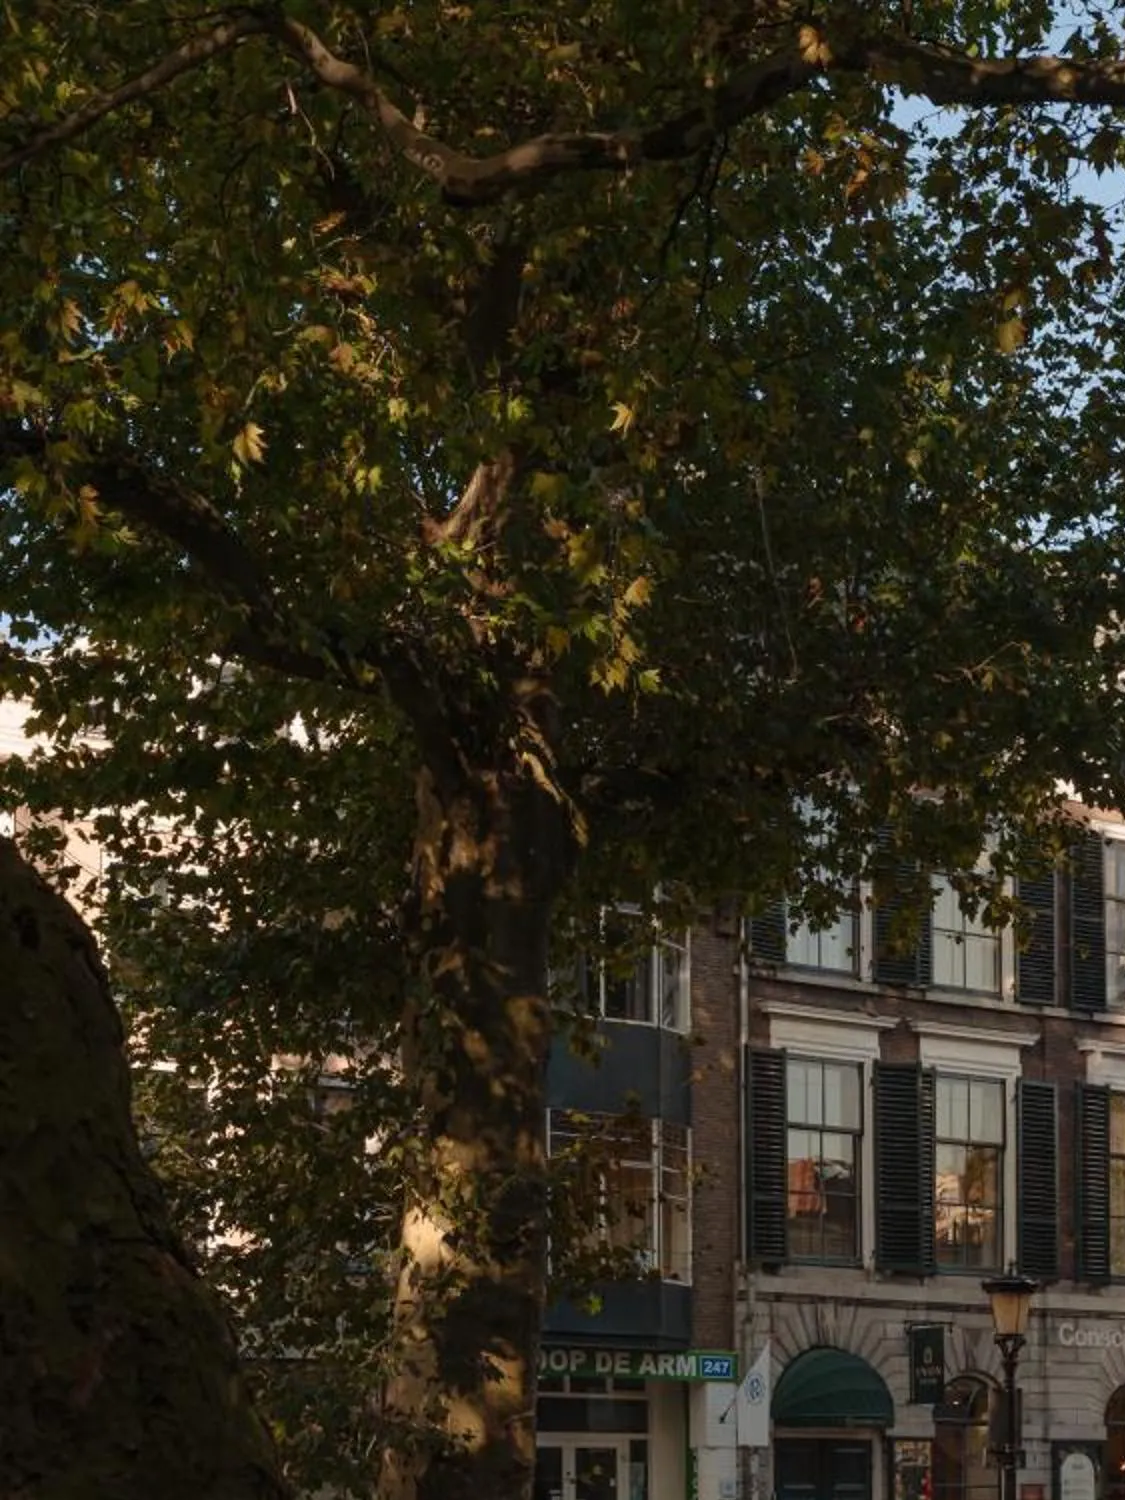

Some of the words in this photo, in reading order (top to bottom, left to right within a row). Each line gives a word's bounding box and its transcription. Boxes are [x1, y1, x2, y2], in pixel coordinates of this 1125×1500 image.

[595, 1352, 631, 1374] DE
[638, 1353, 697, 1377] ARM
[703, 1359, 729, 1374] 247
